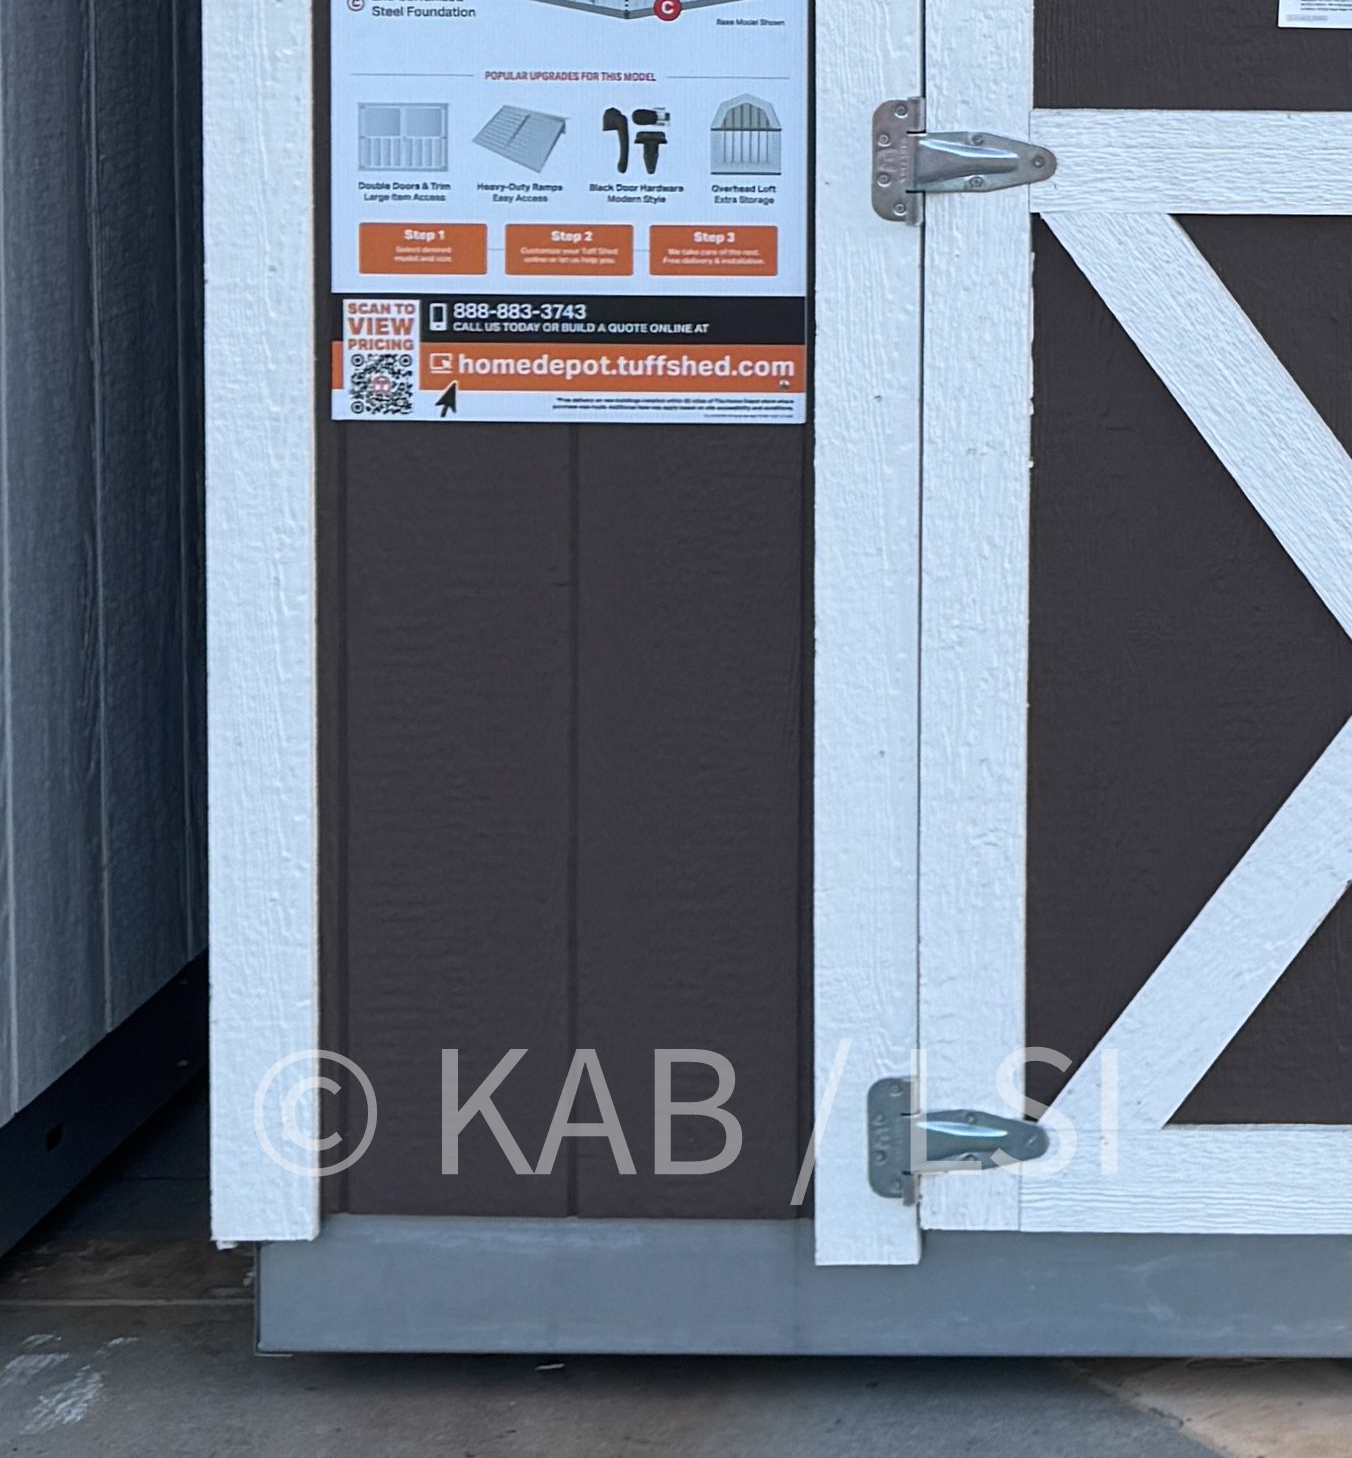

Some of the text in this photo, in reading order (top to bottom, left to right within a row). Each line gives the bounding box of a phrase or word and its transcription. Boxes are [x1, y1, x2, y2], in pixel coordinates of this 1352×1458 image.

[371, 6, 476, 18] Steel Foundation
[484, 70, 657, 82] POPULAR UPGRADES FOR THIS MODEL
[347, 303, 417, 315] SCAN TO
[453, 302, 587, 319] 888-883-3743
[347, 317, 415, 336] VIEW
[452, 321, 710, 334] CALL US TODAY OR BUILD A QUOTE ONLINE AT
[347, 338, 415, 351] PRICING
[457, 353, 795, 381] homedepot.tuffshed.com
